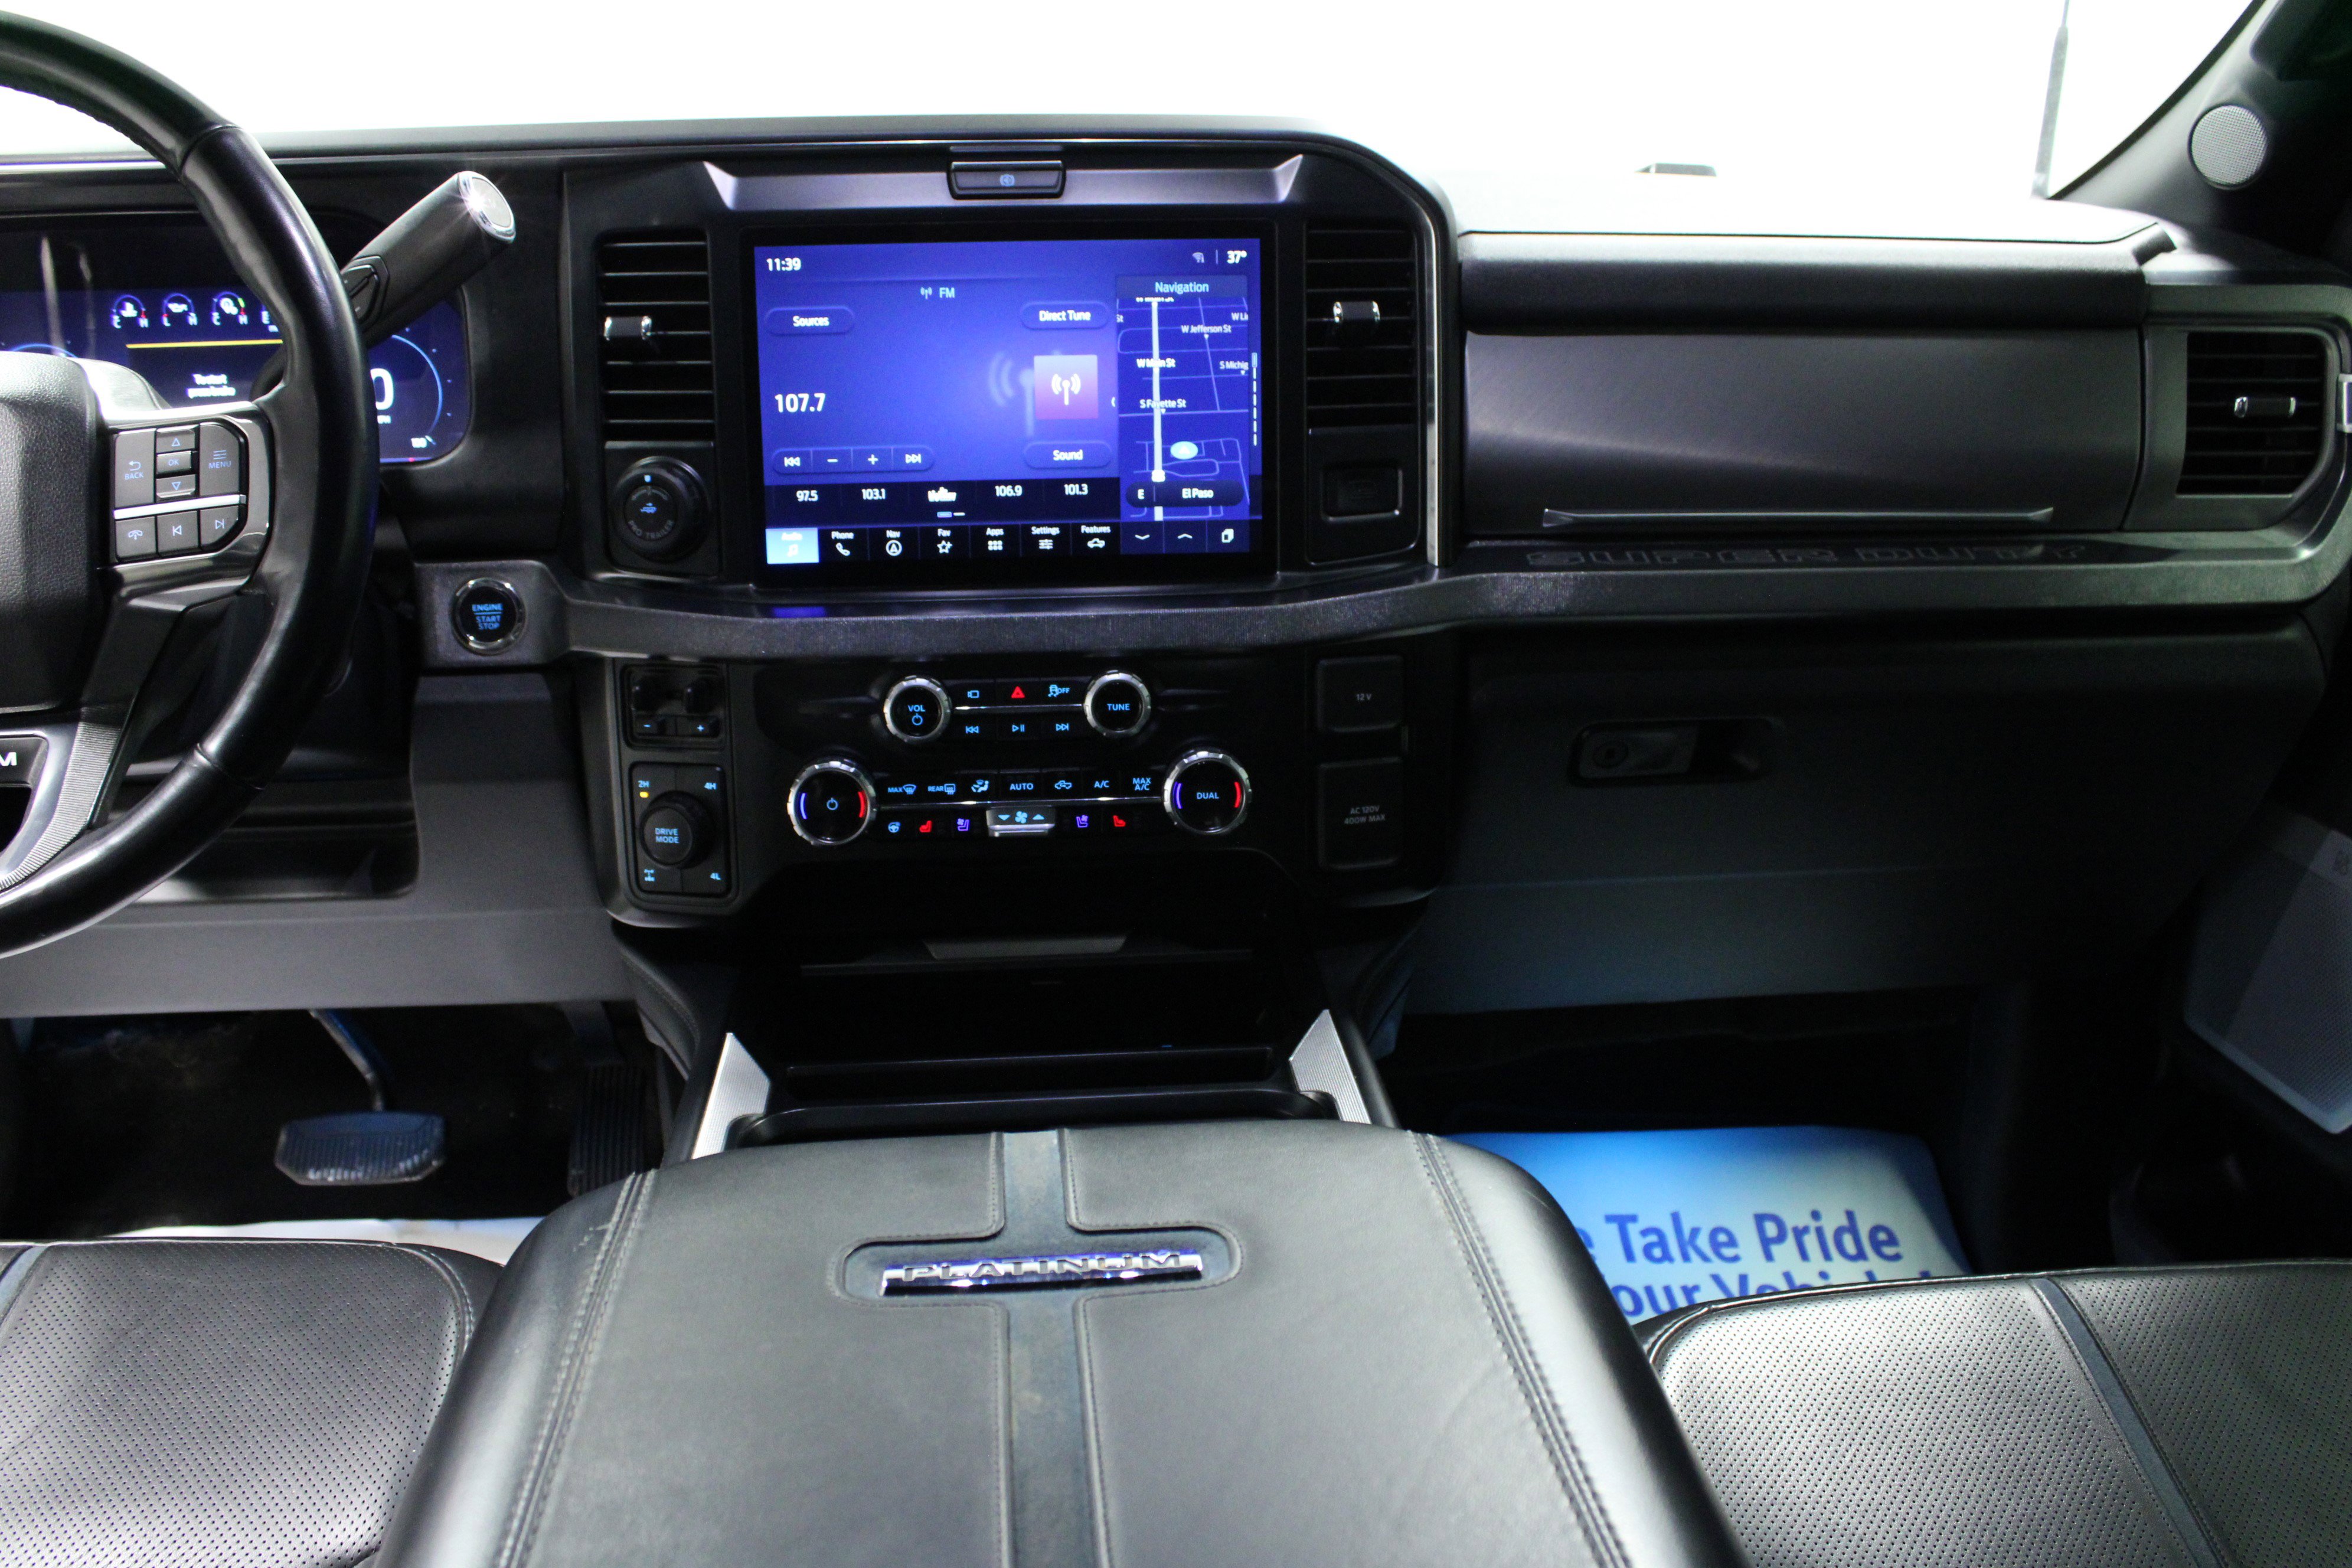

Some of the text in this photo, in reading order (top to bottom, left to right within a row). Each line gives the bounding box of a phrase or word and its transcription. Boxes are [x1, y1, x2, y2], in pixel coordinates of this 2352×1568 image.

[766, 257, 801, 271] 11:39
[939, 288, 955, 299] FM
[1155, 282, 1210, 295] Navigation
[1039, 309, 1091, 322] Direct Tune
[792, 315, 830, 327] Sources
[1181, 324, 1232, 334] W Jefferson St
[1166, 357, 1176, 367] St
[775, 393, 826, 413] 107.7
[1139, 398, 1146, 409] S
[1177, 398, 1187, 408] St
[1053, 449, 1083, 460] Sound
[208, 459, 232, 469] MENU
[125, 472, 144, 480] BACK
[861, 488, 886, 501] 103.1
[995, 485, 1023, 497] 106.9
[1064, 483, 1089, 496] 101.3
[1137, 488, 1145, 500] E
[1192, 487, 1214, 498] Paso
[796, 489, 819, 502] 97.5
[937, 528, 951, 537] Fav
[985, 527, 1004, 537] Apps
[1031, 525, 1060, 535] Settings
[1080, 524, 1111, 534] Features
[831, 531, 854, 540] Phone
[886, 530, 901, 539] Nav
[472, 603, 503, 612] ENGINE
[478, 622, 501, 631] STOP
[907, 704, 926, 713] VOL
[1106, 703, 1130, 711] TUNE
[638, 780, 649, 789] 2H
[1009, 782, 1034, 791] AUTO
[1093, 780, 1110, 789] A/C
[1196, 791, 1220, 799] DUAL
[655, 827, 679, 836] DRIVE
[655, 835, 680, 844] MODE
[1604, 1211, 1743, 1264] Take
[1752, 1208, 1905, 1263] Pride
[901, 1252, 1182, 1282] PLATINUM
[1610, 1281, 1701, 1318] our
